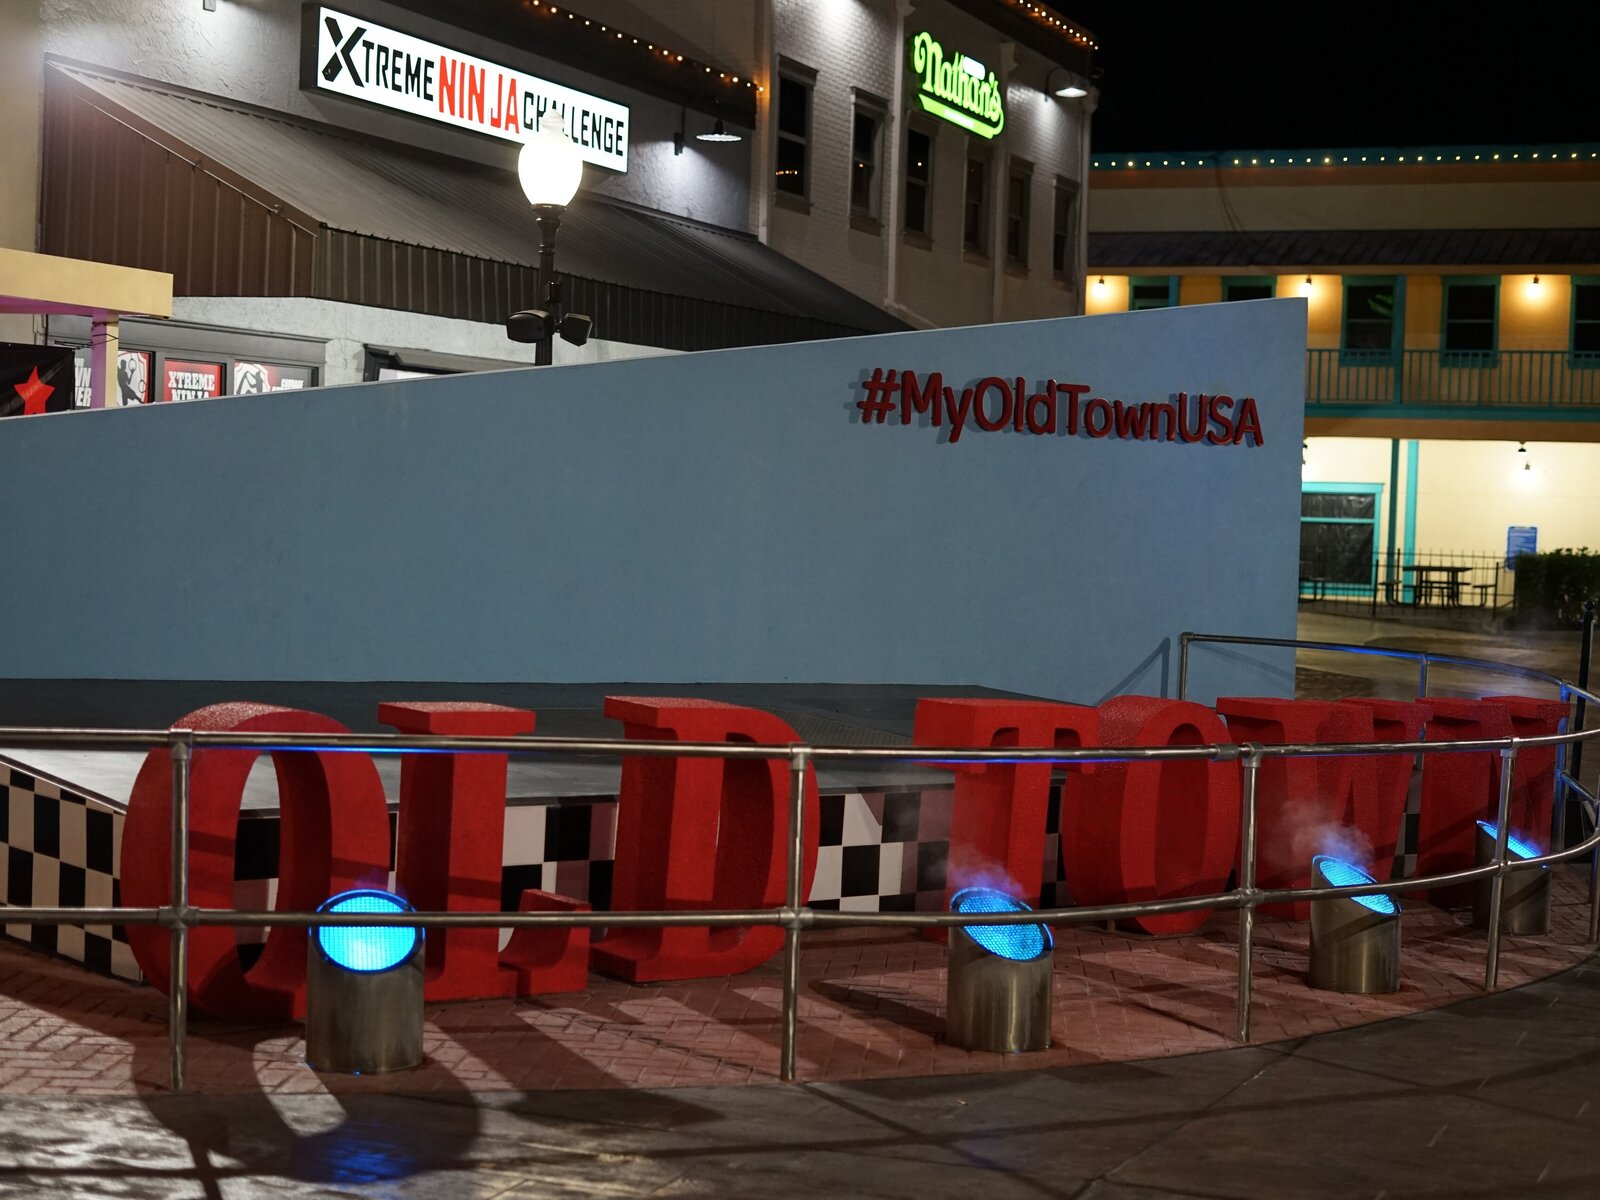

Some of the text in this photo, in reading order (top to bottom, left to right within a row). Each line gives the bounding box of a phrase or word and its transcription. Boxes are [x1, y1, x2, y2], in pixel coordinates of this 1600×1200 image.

[322, 16, 624, 157] XTREME NINJA CHLLENGE
[914, 32, 1001, 122] Nathan's
[168, 371, 215, 392] XTREME
[862, 368, 1264, 446] #MyOldTownUSA
[120, 694, 820, 1021] OLD
